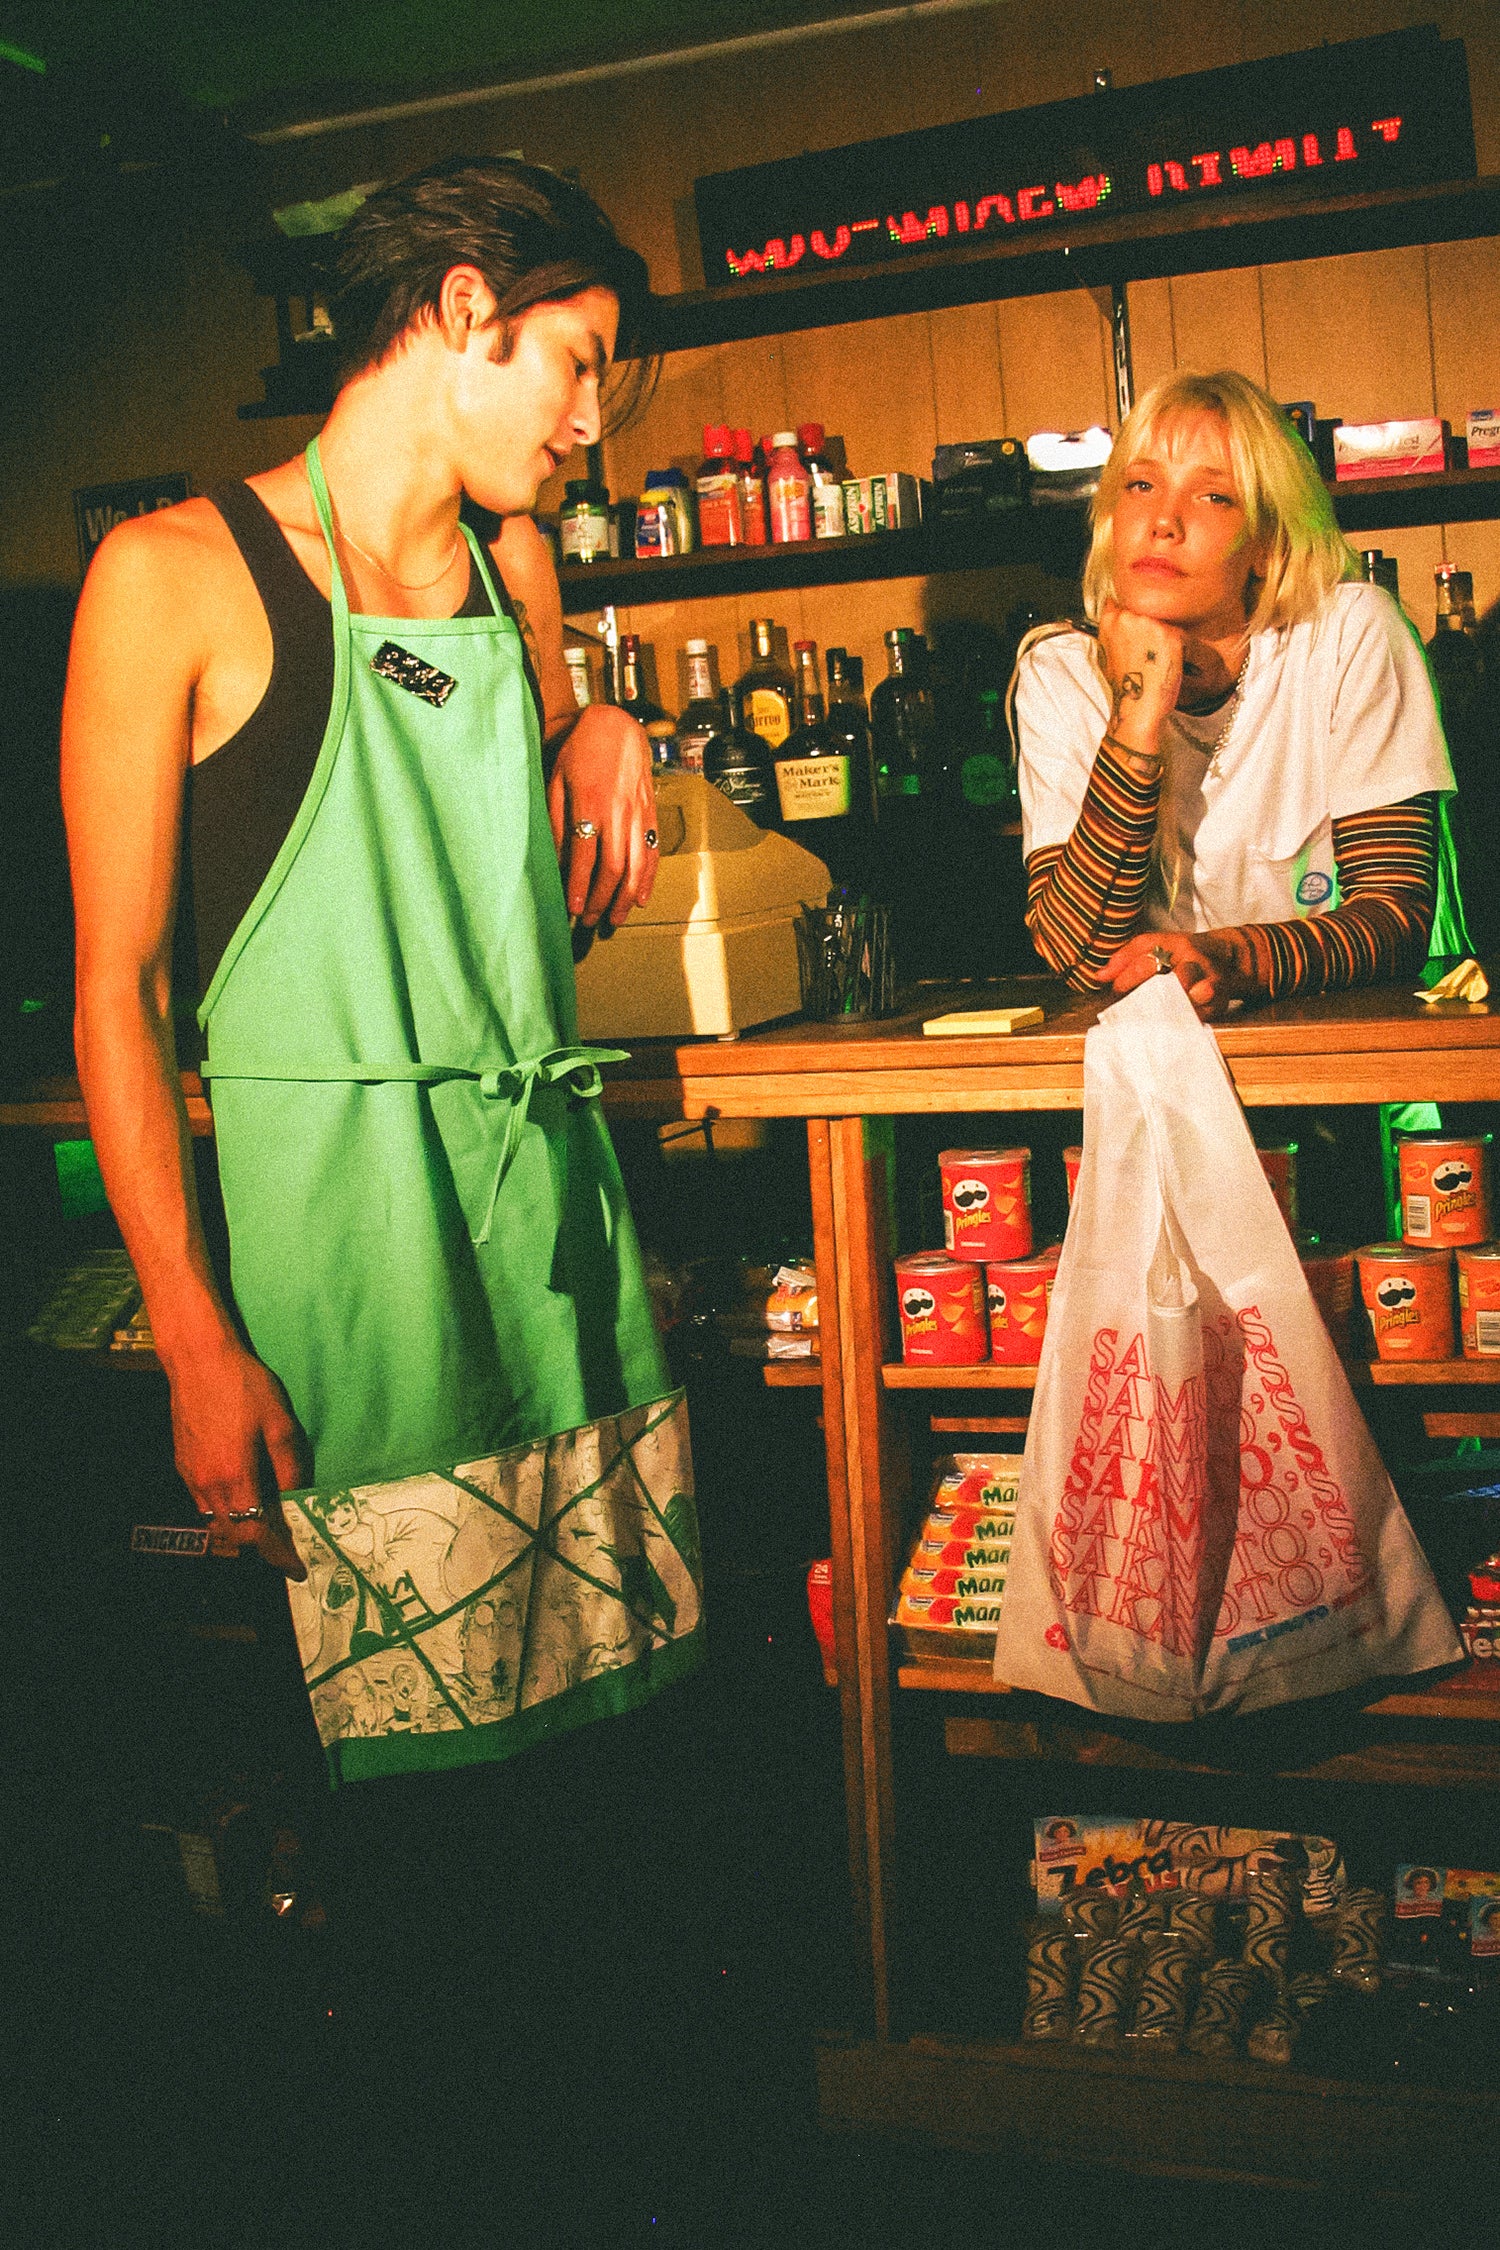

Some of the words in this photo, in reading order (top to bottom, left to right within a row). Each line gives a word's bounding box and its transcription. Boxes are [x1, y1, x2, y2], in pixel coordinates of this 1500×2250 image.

[753, 714, 782, 727] uervo
[783, 764, 840, 778] Maker's
[799, 775, 841, 789] Mark
[1435, 1192, 1477, 1221] Pringles
[956, 1210, 992, 1232] Pringles
[905, 1317, 938, 1336] Pringles
[1378, 1308, 1421, 1335] Pringles
[1048, 1849, 1174, 1896] Zebra
